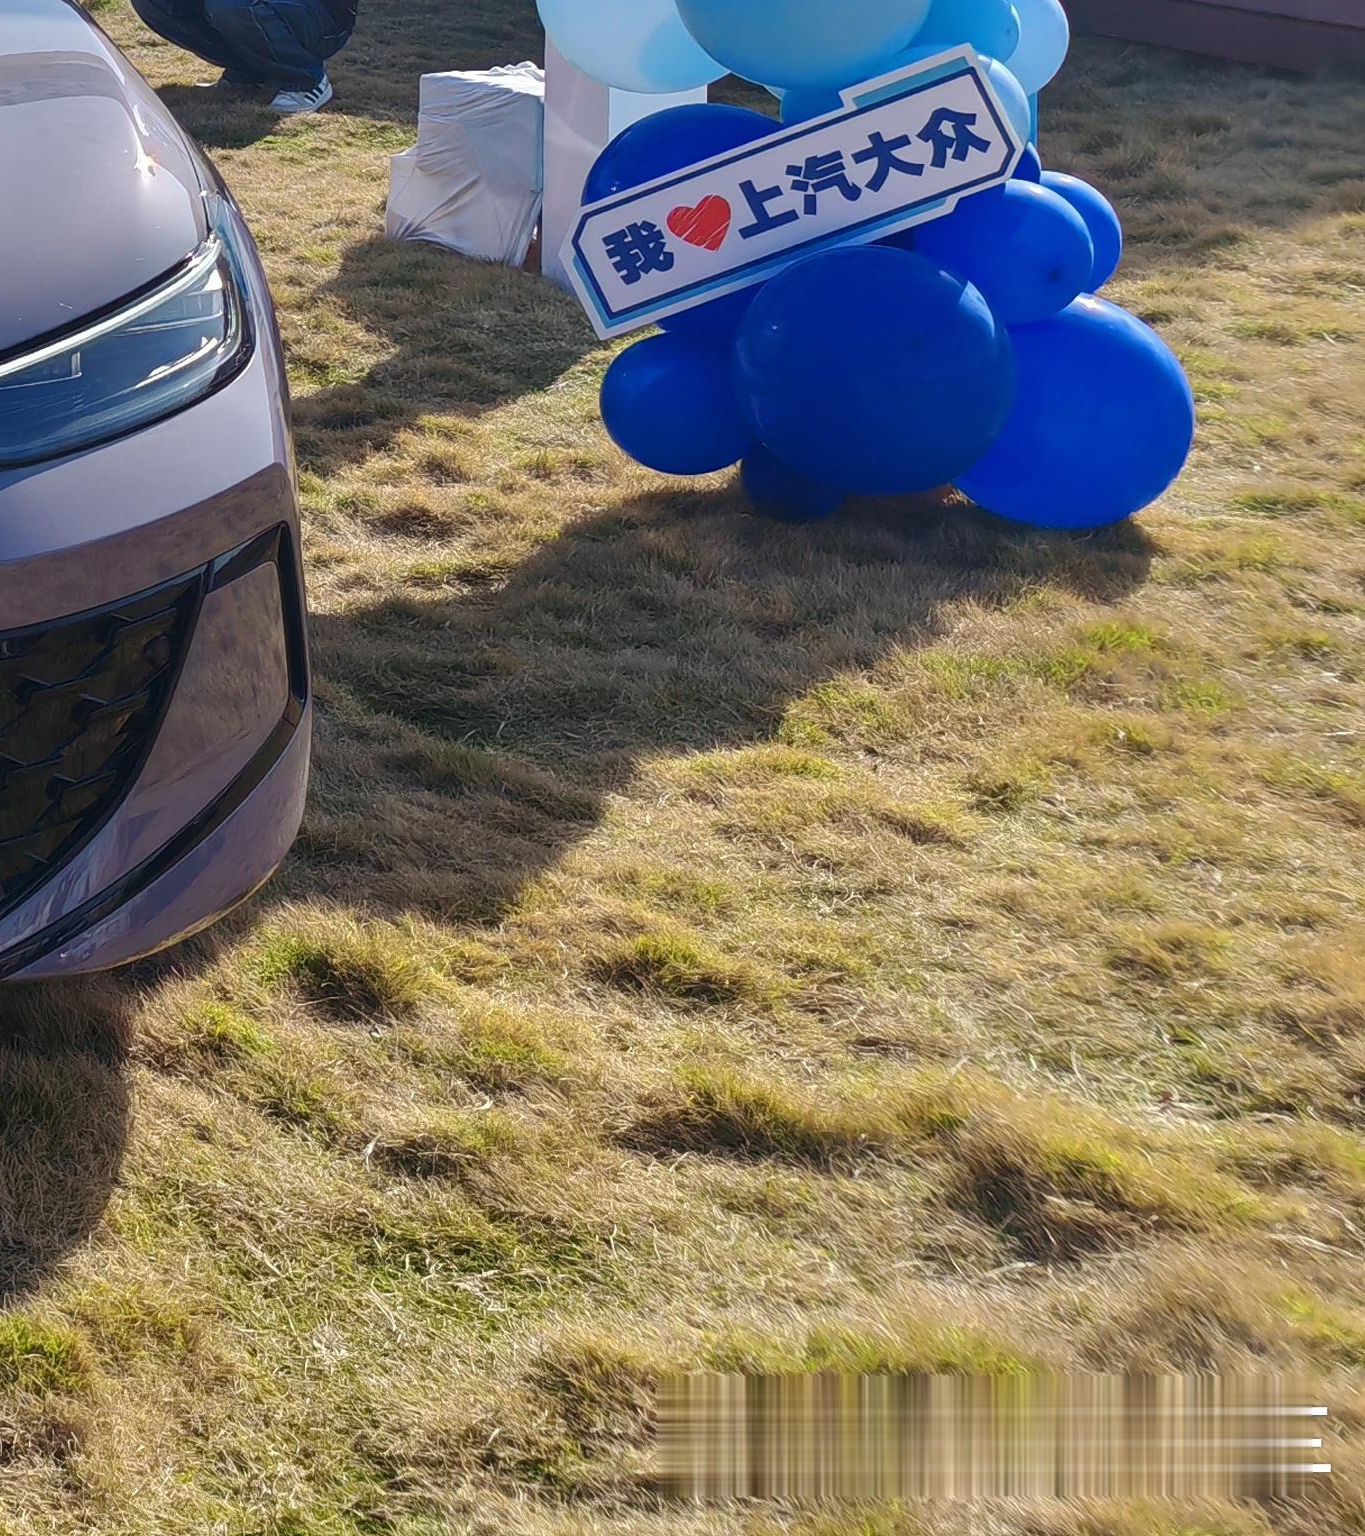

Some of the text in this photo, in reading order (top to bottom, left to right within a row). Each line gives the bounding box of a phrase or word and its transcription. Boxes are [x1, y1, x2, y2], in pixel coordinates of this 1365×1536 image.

[601, 106, 993, 286] 我 上汽大众
